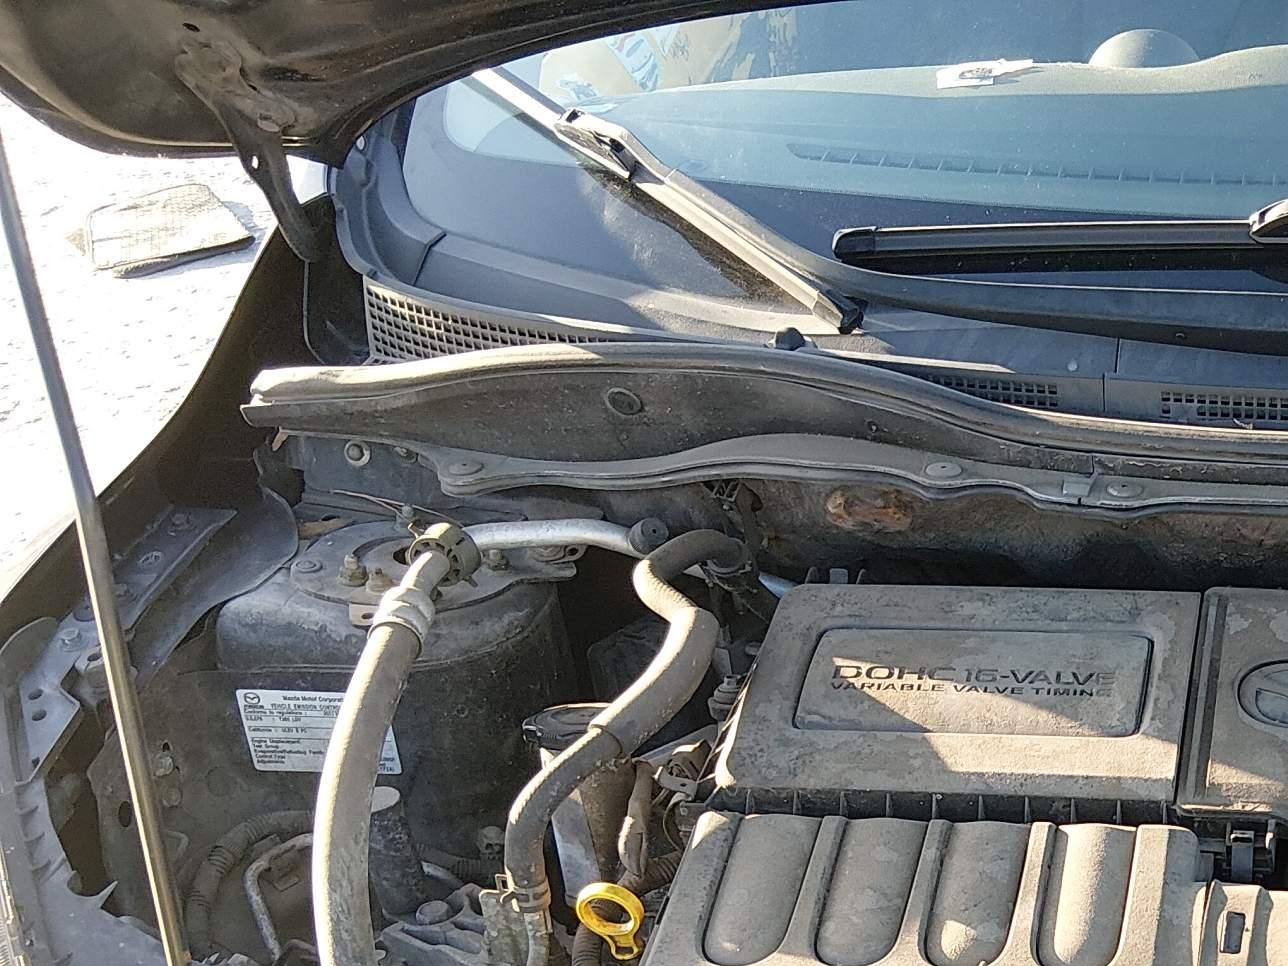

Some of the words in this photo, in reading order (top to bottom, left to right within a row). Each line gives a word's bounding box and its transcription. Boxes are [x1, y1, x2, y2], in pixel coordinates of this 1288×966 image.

[832, 665, 957, 682] DOHC
[964, 667, 1116, 686] 16-VALVE
[832, 682, 945, 692] VARIABLE
[953, 685, 1025, 696] VALVE
[1032, 687, 1113, 698] TIMING
[318, 696, 345, 704] Corporati
